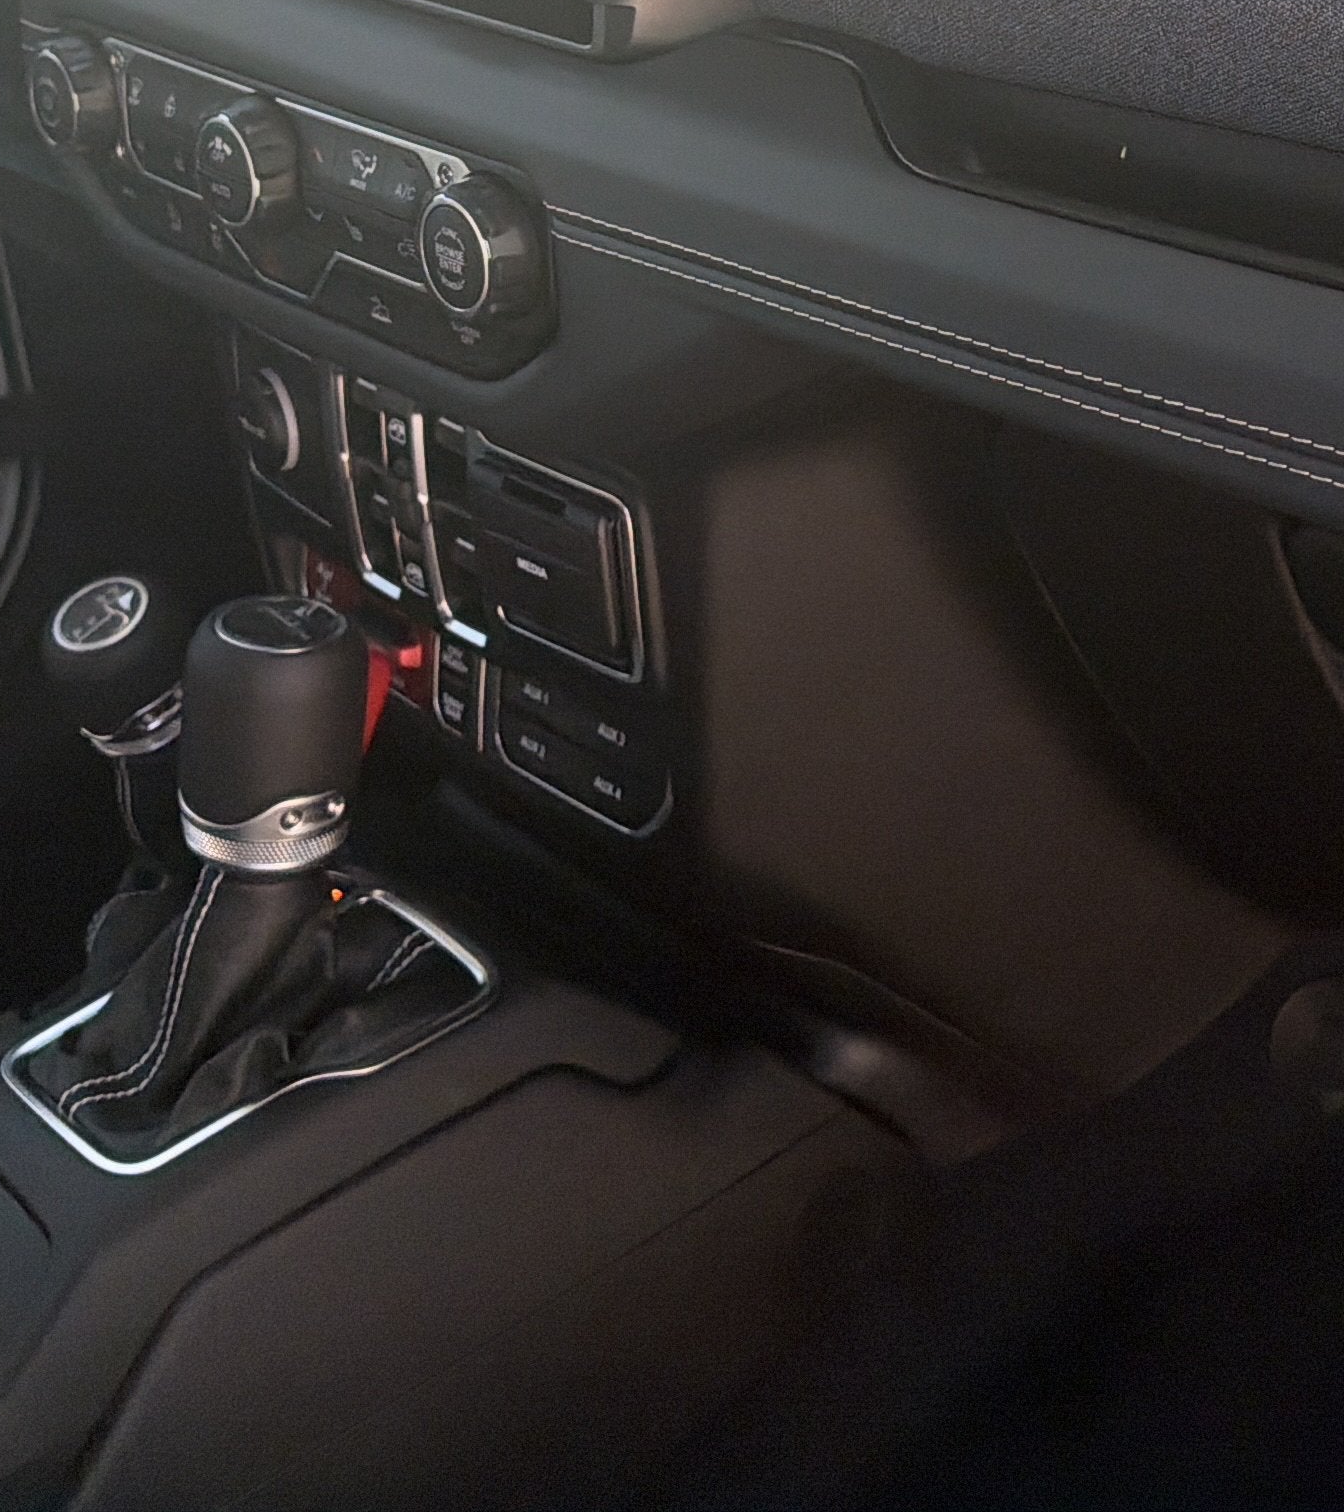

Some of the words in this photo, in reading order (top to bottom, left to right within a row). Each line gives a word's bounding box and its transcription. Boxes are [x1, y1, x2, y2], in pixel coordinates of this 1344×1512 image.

[394, 182, 417, 201] A/C
[434, 242, 465, 261] BROWSE
[439, 257, 463, 275] ENTER
